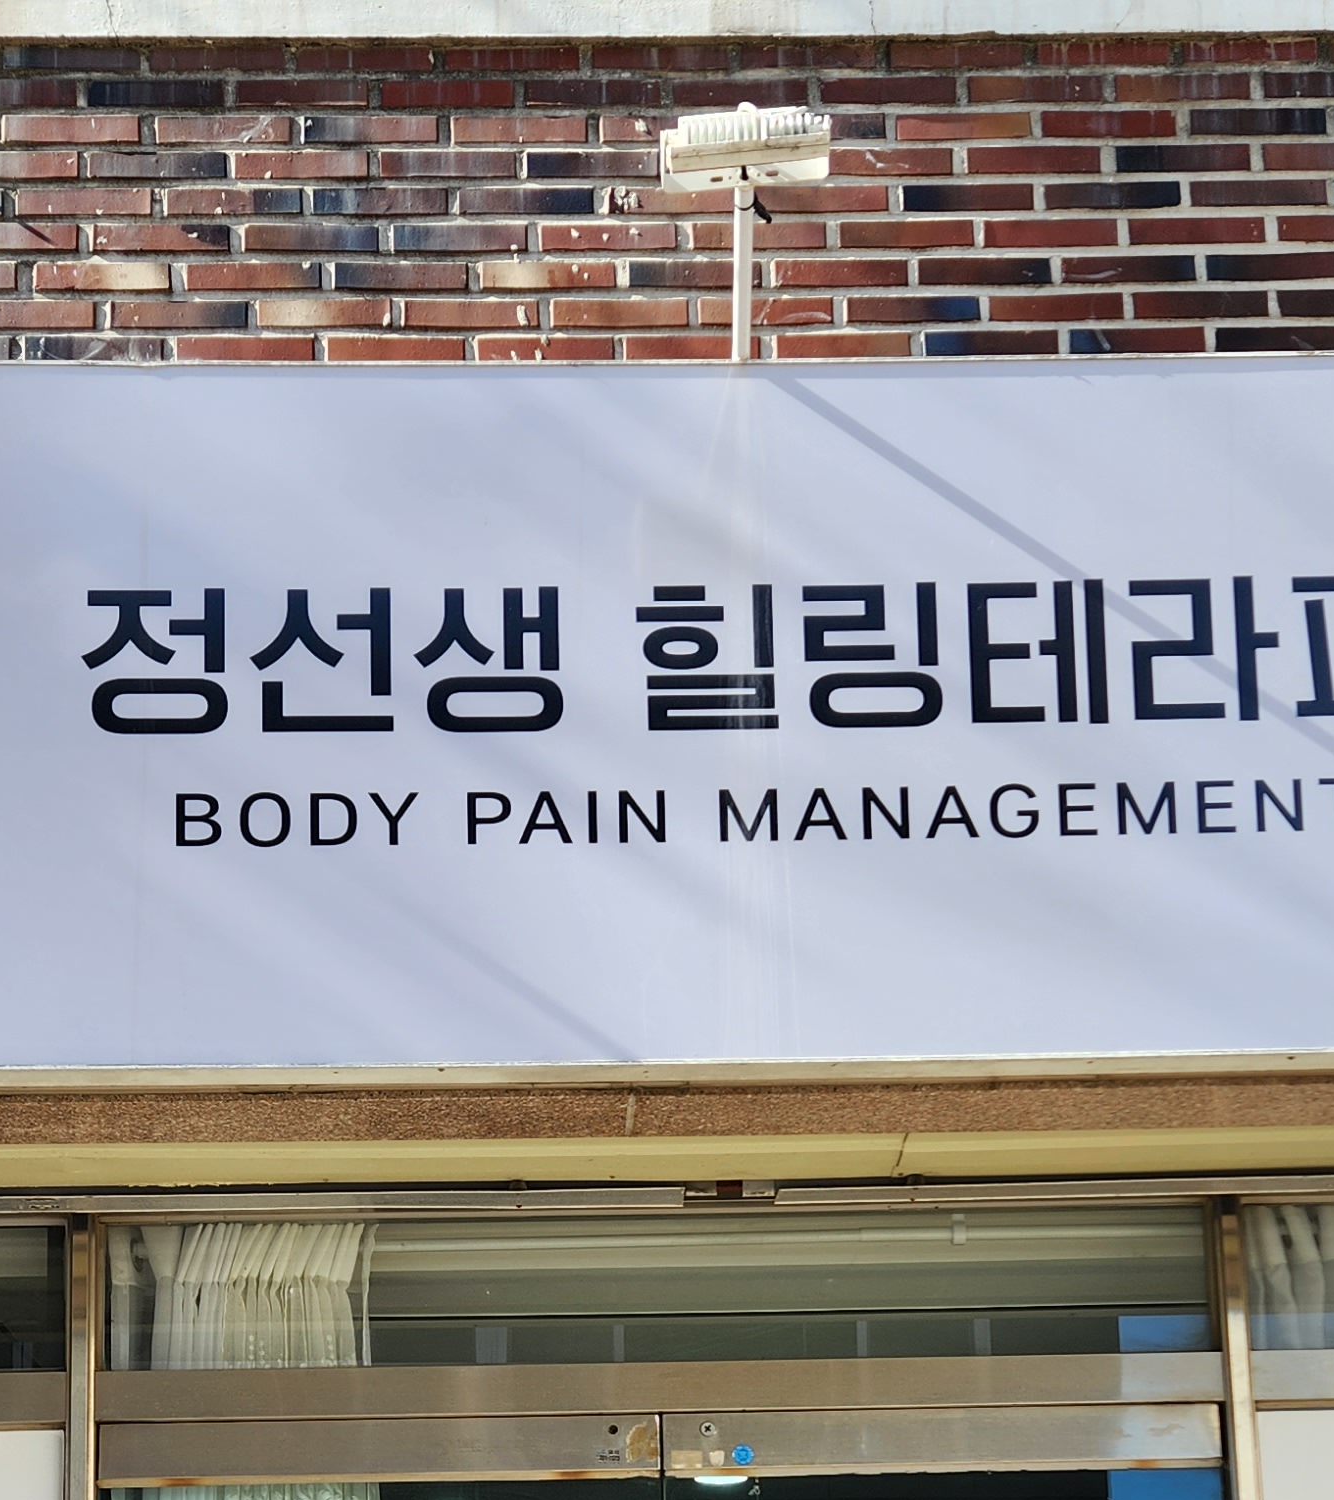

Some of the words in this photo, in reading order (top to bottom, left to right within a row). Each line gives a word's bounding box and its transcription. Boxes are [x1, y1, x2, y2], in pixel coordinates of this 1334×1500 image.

[81, 585, 565, 736] 정선생
[174, 790, 420, 849] BODY
[465, 788, 668, 846] PAIN
